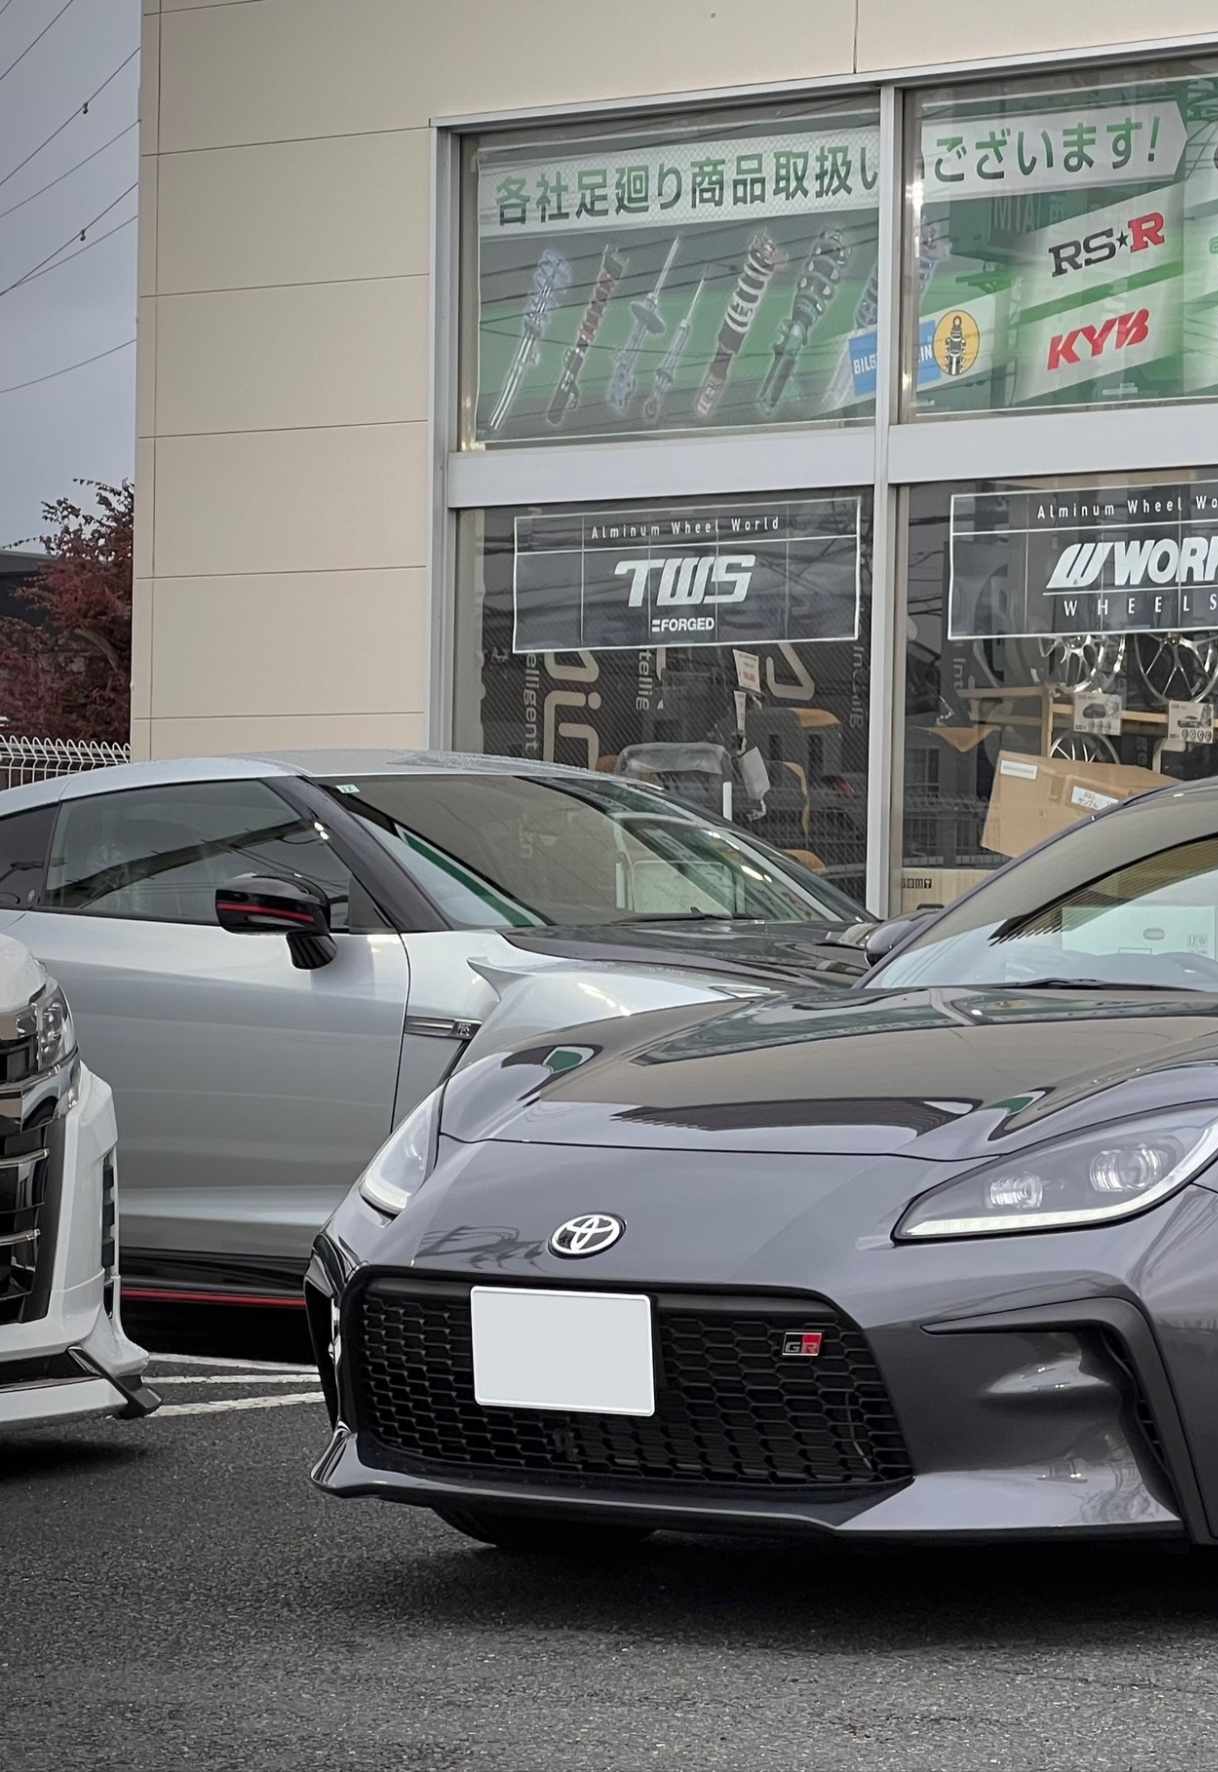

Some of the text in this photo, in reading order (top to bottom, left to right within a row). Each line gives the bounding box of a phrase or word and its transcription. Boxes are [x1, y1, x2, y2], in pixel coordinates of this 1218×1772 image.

[1047, 308, 1150, 371] KYB
[1037, 502, 1115, 520] Alminum
[1127, 496, 1182, 514] Wheel
[591, 515, 780, 540] Alminum Wheel World
[614, 554, 756, 608] TWS
[1064, 593, 1218, 617] WHEELS
[660, 617, 715, 633] FORGED
